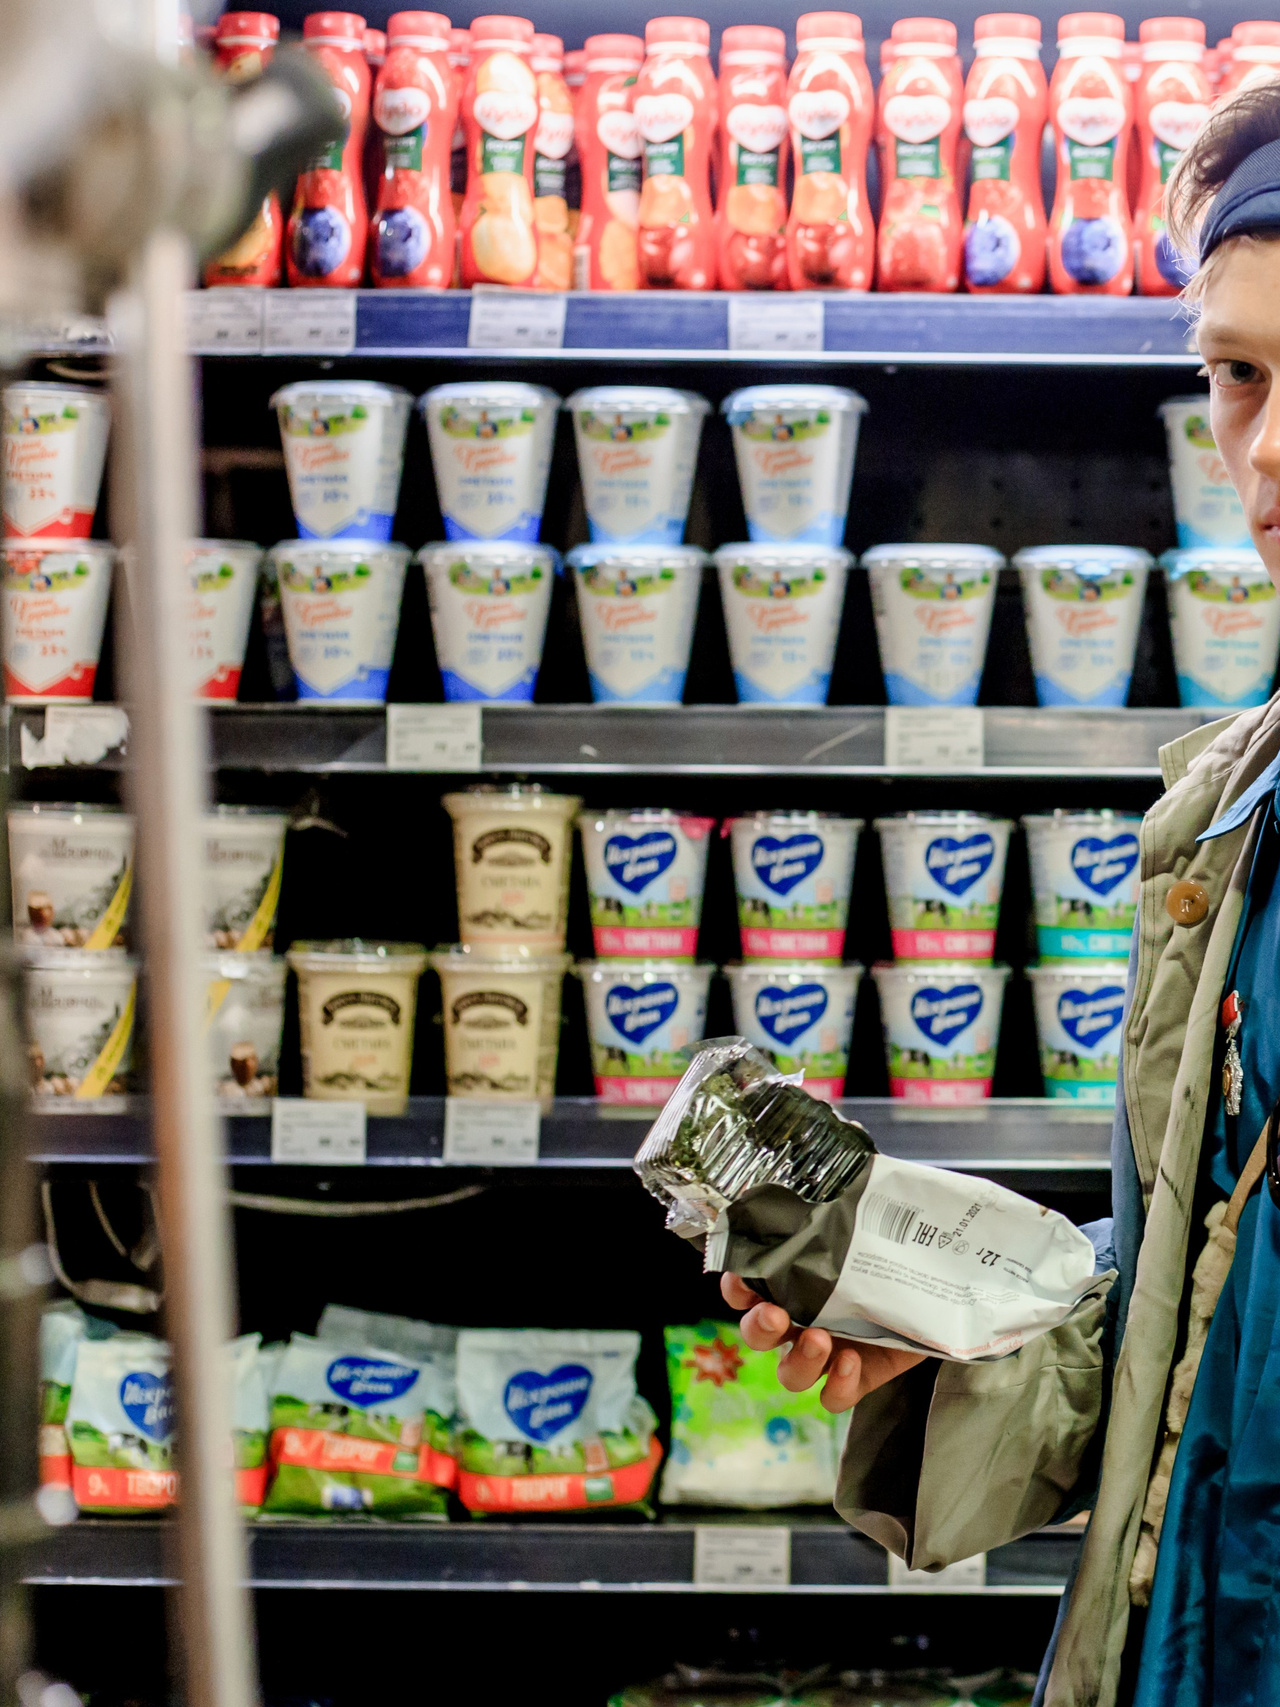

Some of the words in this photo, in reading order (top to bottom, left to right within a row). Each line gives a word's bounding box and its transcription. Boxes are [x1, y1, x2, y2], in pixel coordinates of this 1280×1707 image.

[952, 1202, 984, 1238] 21.01.2021
[981, 1249, 1002, 1267] 12
[125, 1471, 178, 1498] ТВОРО
